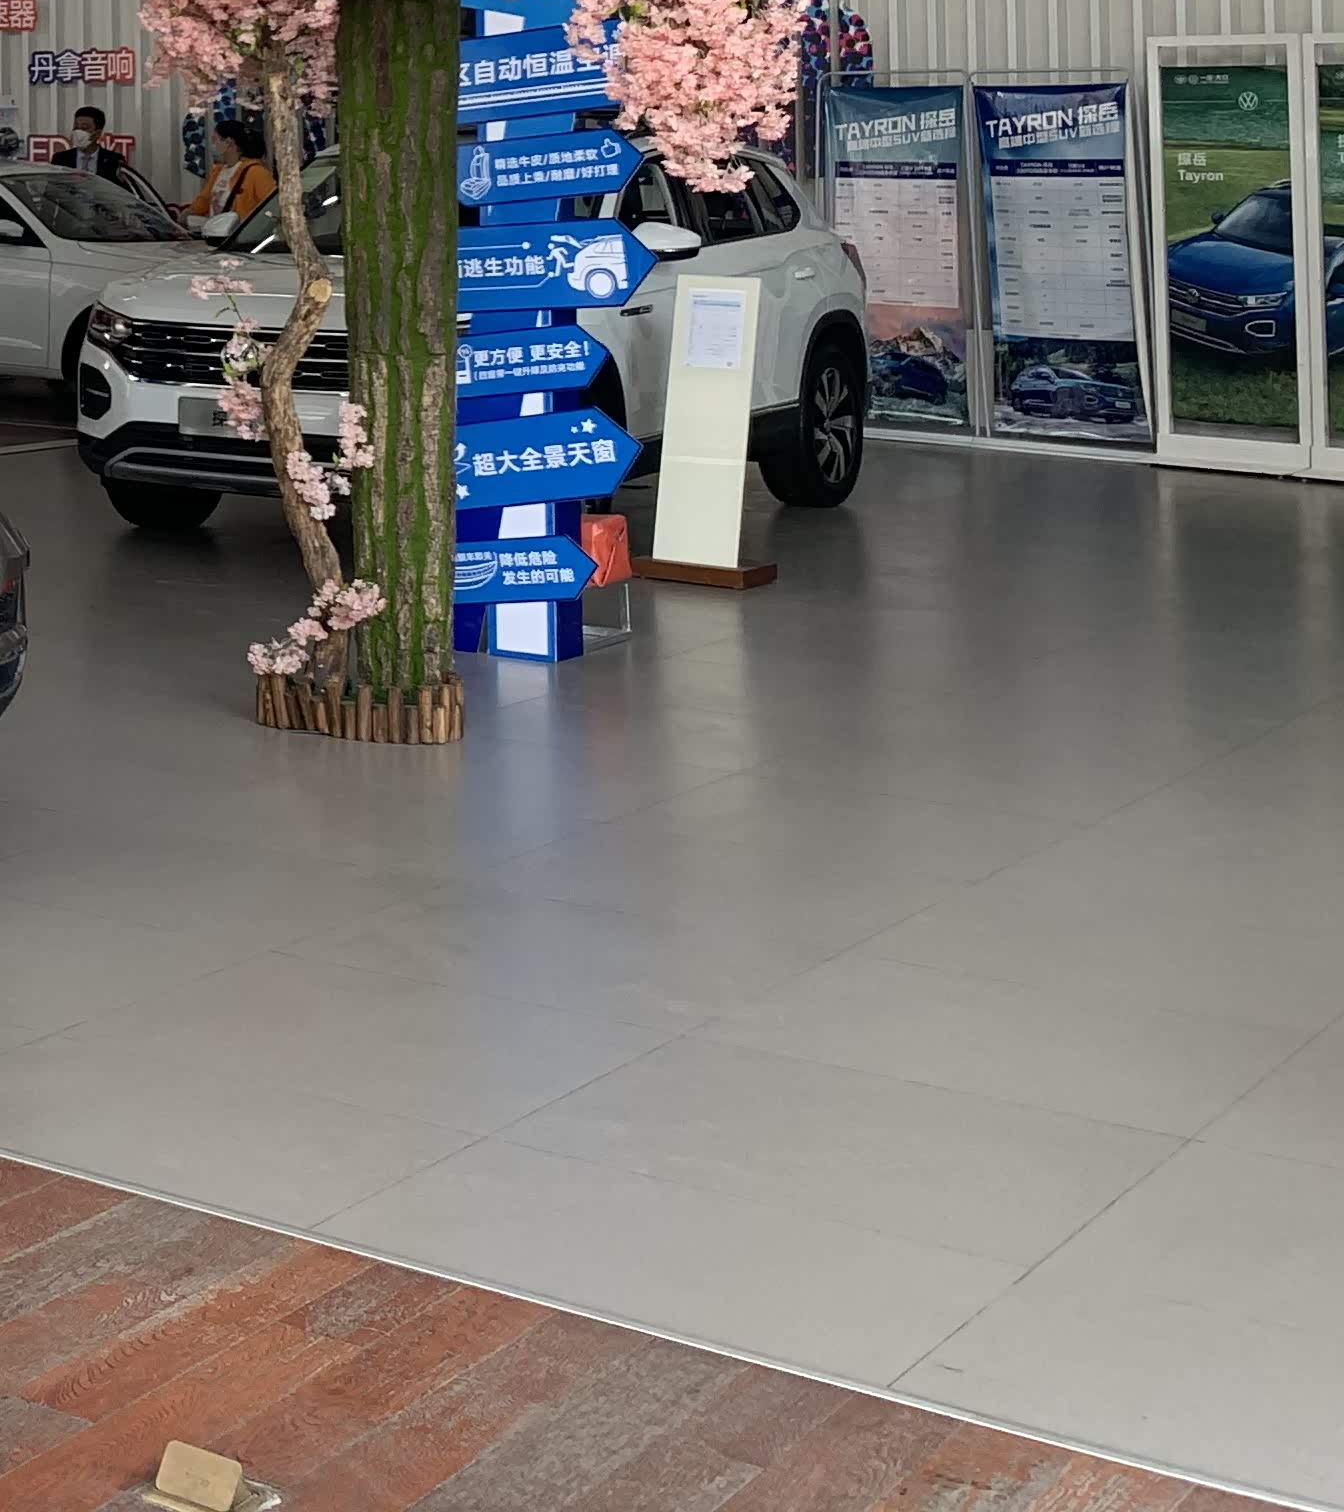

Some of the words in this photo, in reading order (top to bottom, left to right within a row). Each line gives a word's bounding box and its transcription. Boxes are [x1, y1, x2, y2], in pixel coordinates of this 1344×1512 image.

[30, 50, 135, 83] 丹拿音响
[834, 113, 916, 141] TAYRON
[986, 108, 1073, 138] TAYRON
[1177, 168, 1224, 184] Tayron
[457, 255, 546, 279] 逃生功能
[474, 346, 524, 368] 更方便
[473, 438, 618, 477] 超大全景天窗
[498, 550, 558, 568] 降低危险
[502, 568, 576, 586] 发生的可能
